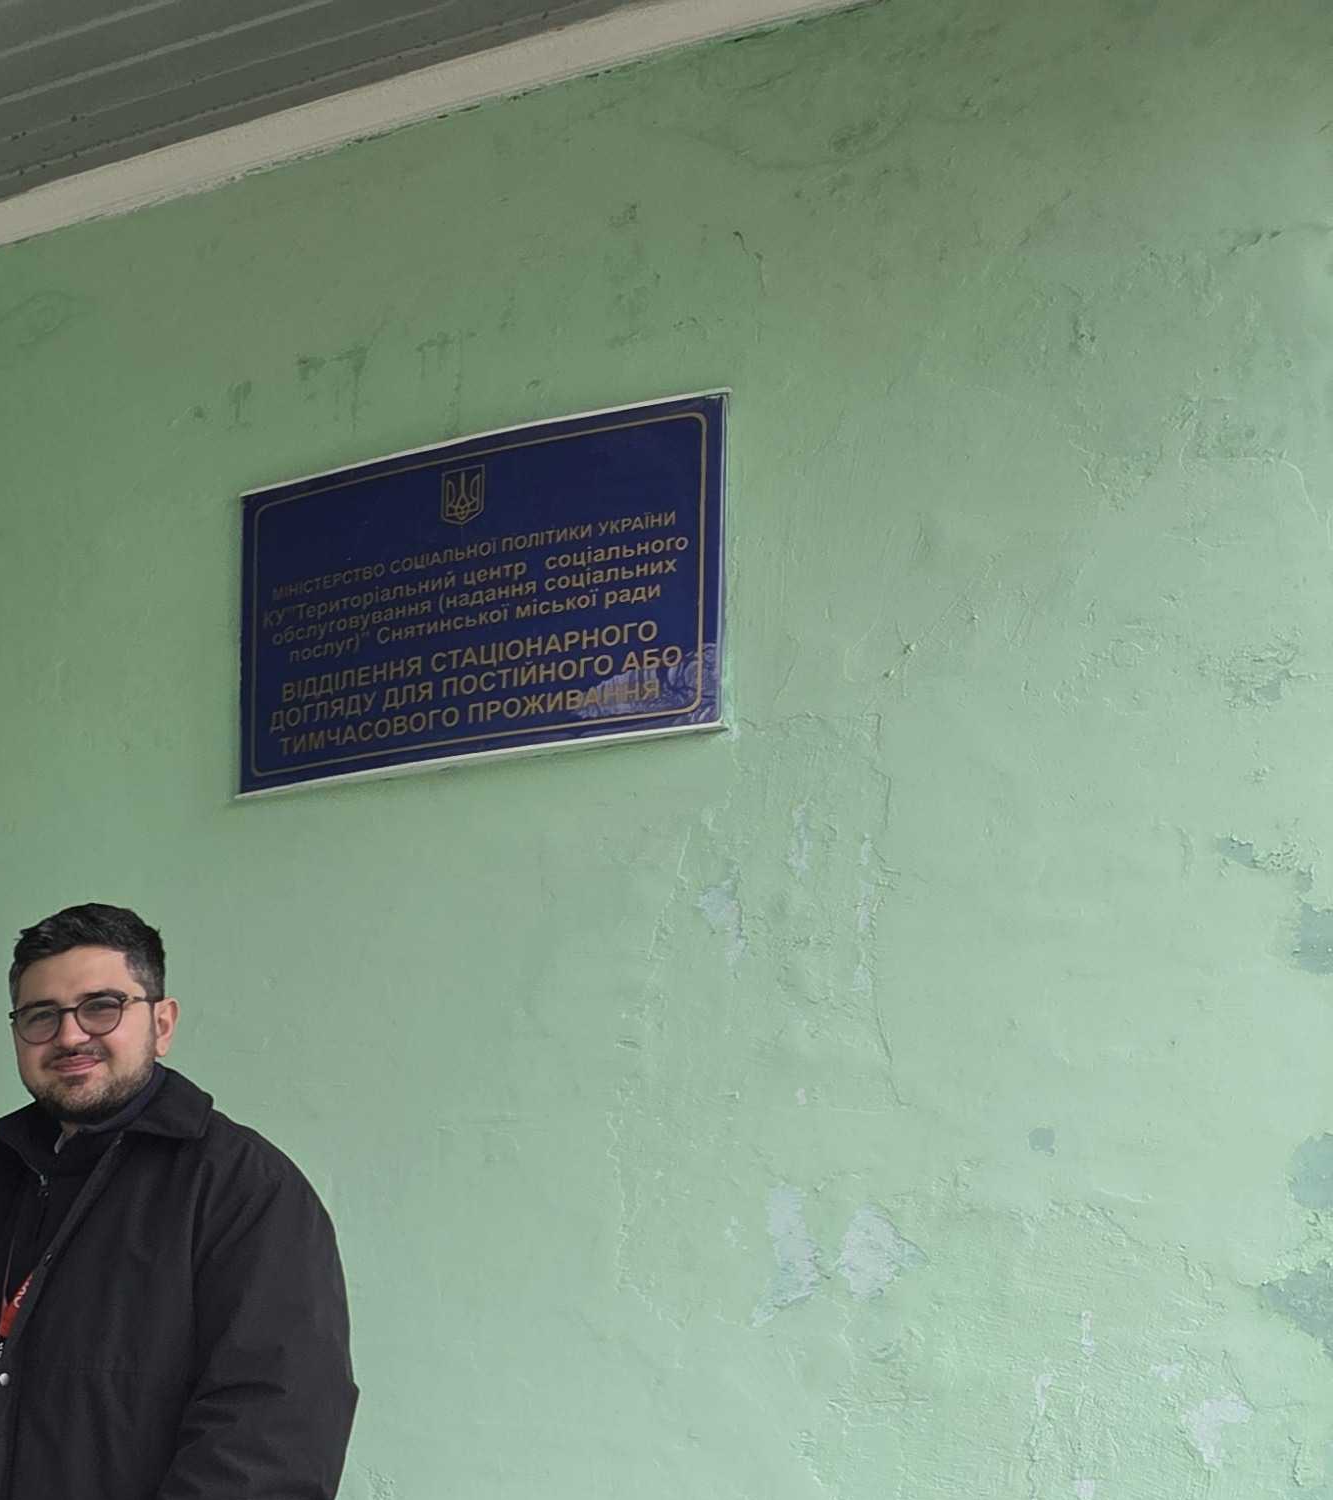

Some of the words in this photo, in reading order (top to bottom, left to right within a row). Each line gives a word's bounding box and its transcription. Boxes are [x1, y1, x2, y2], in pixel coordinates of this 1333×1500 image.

[273, 562, 385, 600] МІНІСТЕРСТВО
[390, 537, 498, 575] СОЦІАЛЬНОЇ
[501, 523, 592, 552] ПОЛІТИКИ
[598, 510, 676, 536] УКРАЇНИ
[463, 562, 527, 586] центр
[544, 536, 689, 570] соціального
[271, 600, 432, 646] обслуговування
[438, 581, 537, 614] (надання
[544, 558, 677, 592] соціальних
[377, 604, 509, 644] Снятинської
[515, 588, 597, 619] міської
[604, 584, 661, 609] ради
[270, 691, 376, 733] ДОГЛЯДУ
[383, 681, 432, 710] ДЛЯ
[442, 654, 613, 698] ПОСТІЙНОГО
[621, 645, 682, 674] АБО
[283, 656, 422, 702] ВІДДІЛЕННЯ
[431, 620, 658, 673] СТАЦІОНАРНОГО
[279, 707, 459, 756] ТИМЧАСОВОГО
[468, 679, 660, 724] ПРОЖИВАННЯ
